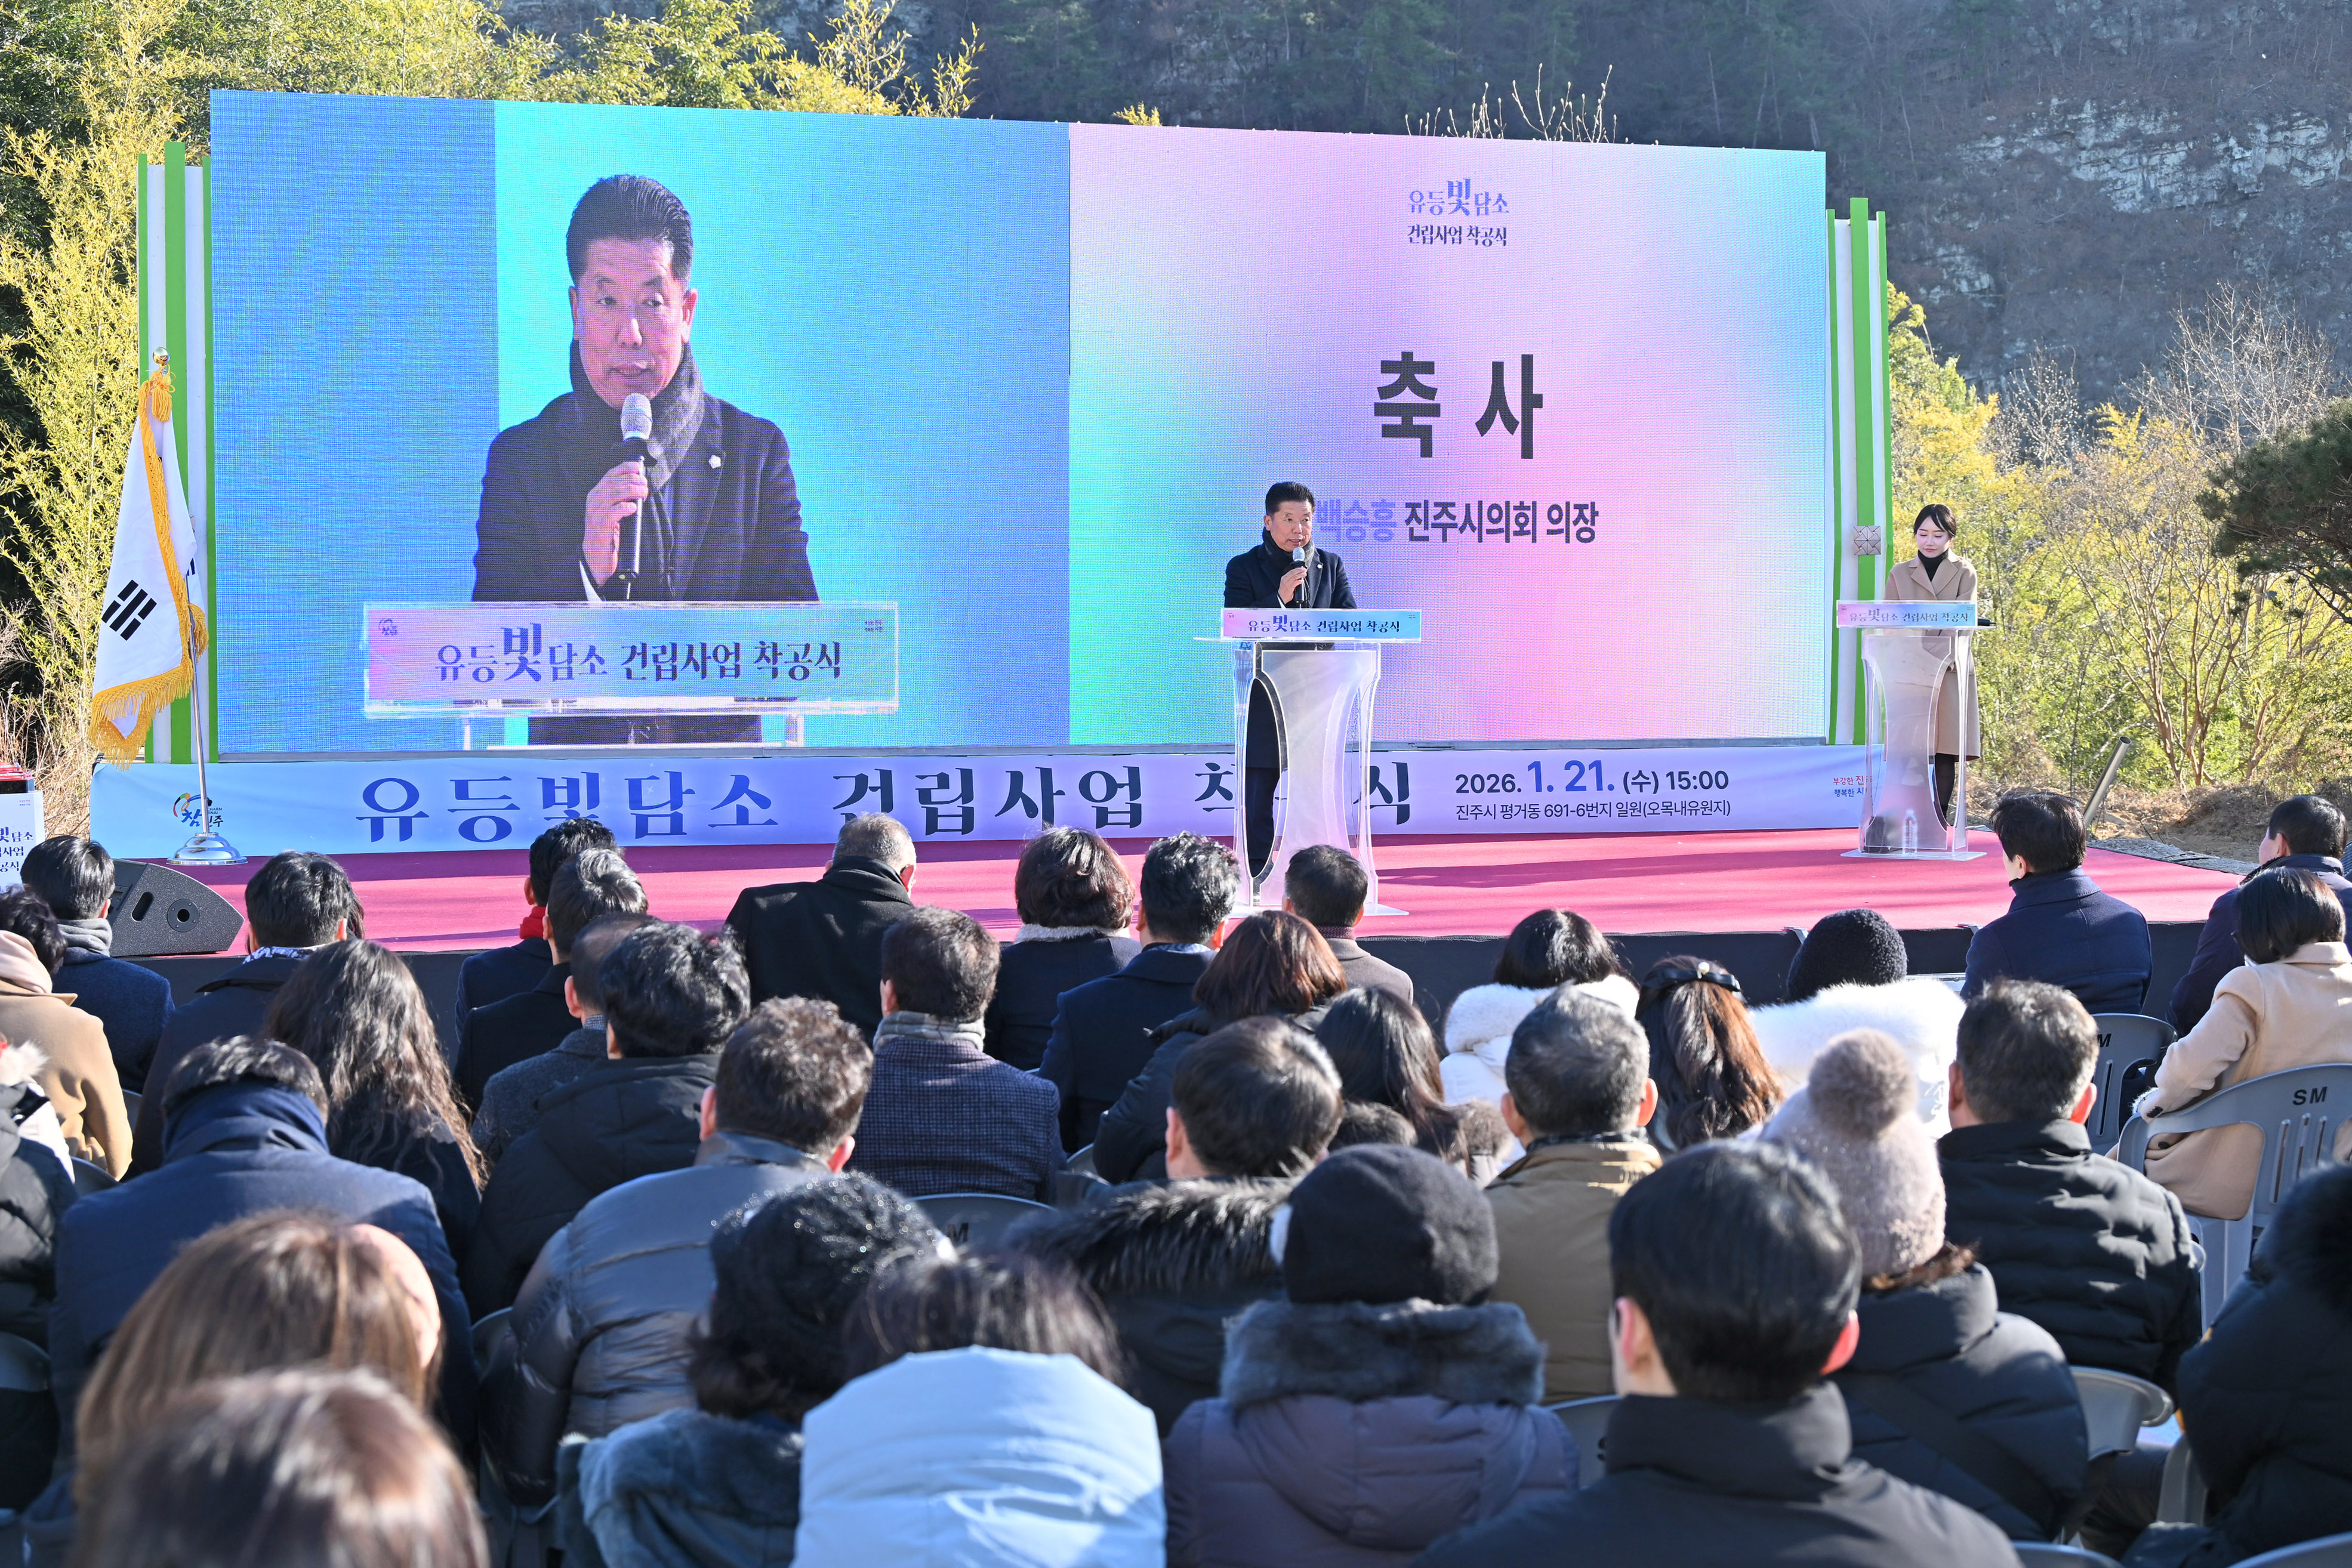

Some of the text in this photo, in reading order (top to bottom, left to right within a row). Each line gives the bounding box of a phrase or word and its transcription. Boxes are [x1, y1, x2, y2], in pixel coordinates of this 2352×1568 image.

[1408, 179, 1509, 216] 유등빛담소
[1407, 224, 1507, 246] 건립사업 착공식
[1316, 499, 1599, 544] 백승흥 진주시의회 의장
[1247, 615, 1400, 633] 유등빛담소 건립사업 착공식
[1849, 609, 1969, 622] 유등빛담소 건립사업 착공식
[435, 622, 841, 682] 유등빛담소 건립사업 착공식
[1455, 760, 1730, 794] 2026. 1. 21. (수) 15:00
[1834, 789, 1854, 797] 행복한
[1456, 800, 1731, 820] 진주시 평거동 691-6번지 일원(오목내유원지)
[0, 846, 24, 857] 사업
[2292, 1086, 2328, 1106] SM
